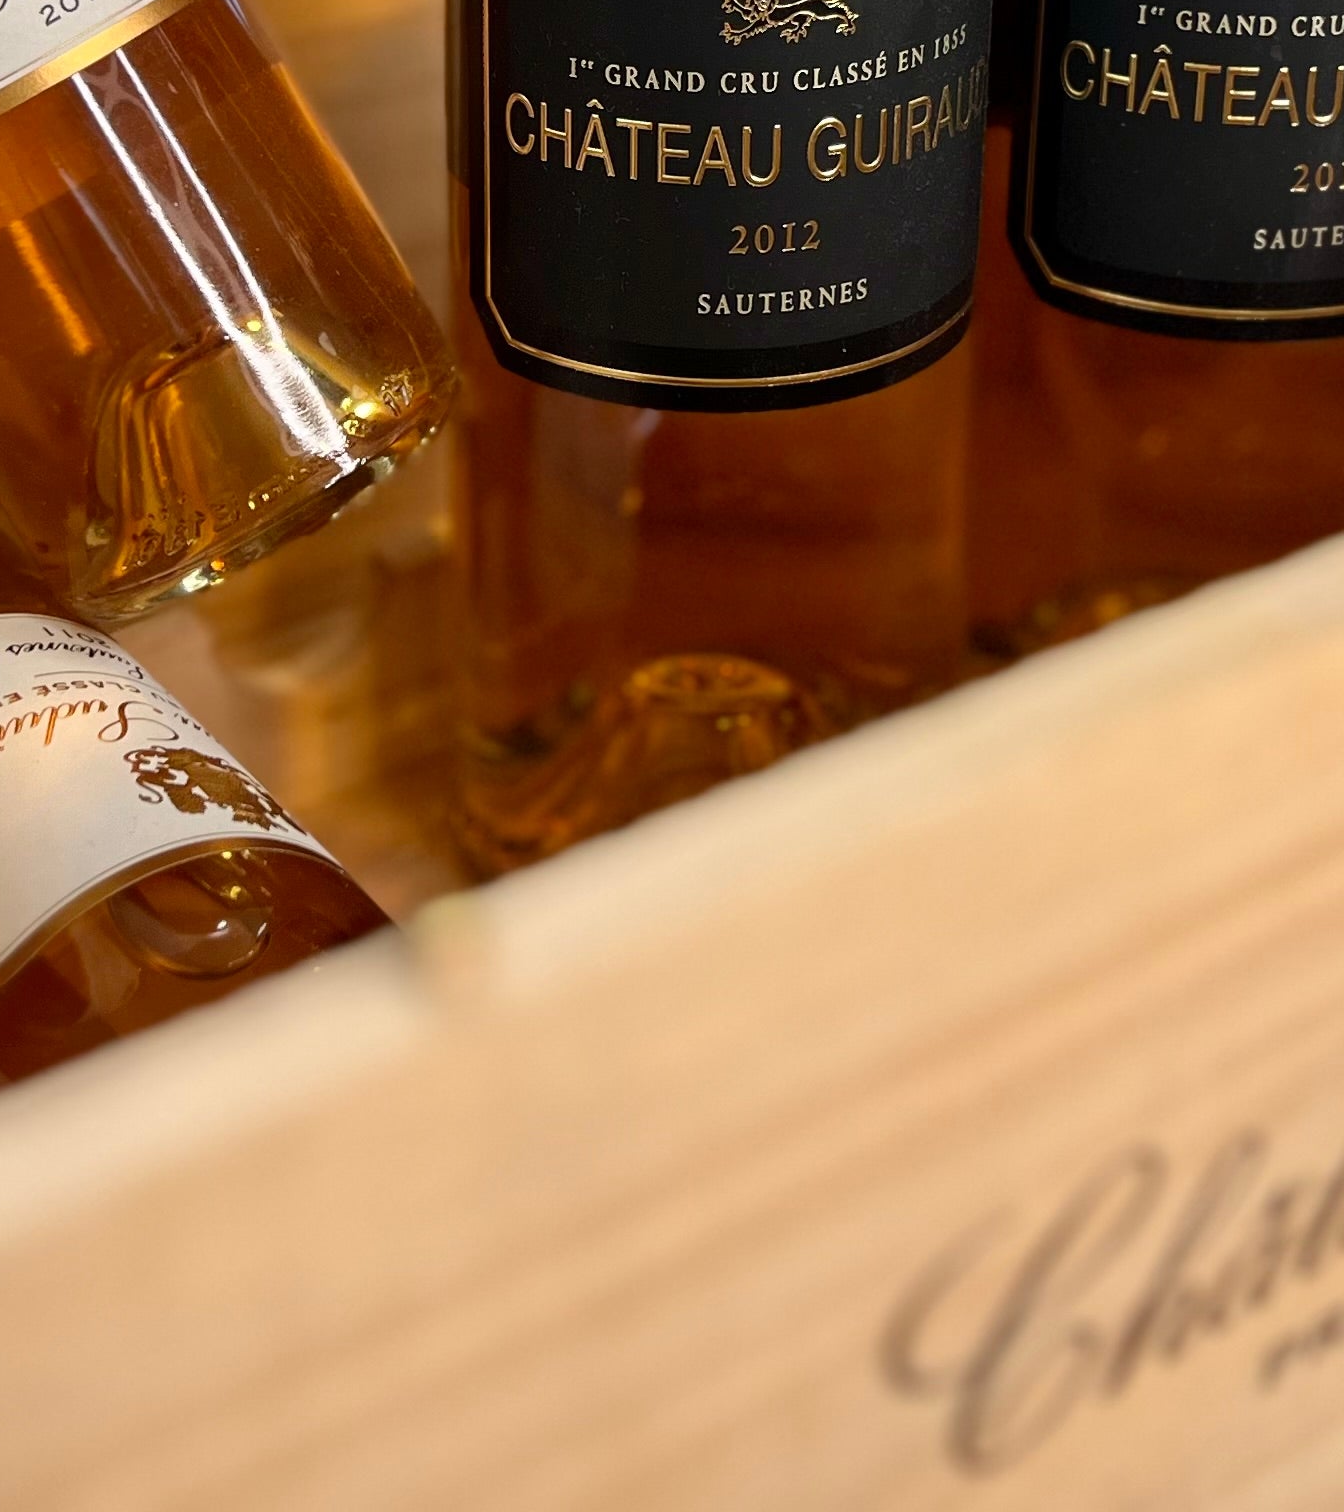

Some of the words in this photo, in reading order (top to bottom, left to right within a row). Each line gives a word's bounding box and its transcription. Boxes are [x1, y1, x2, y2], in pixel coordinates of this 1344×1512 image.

[1175, 8, 1278, 38] GRAND
[605, 65, 706, 93] GRAND
[720, 71, 780, 94] CRU
[793, 52, 888, 91] CLASSÉ
[898, 43, 925, 73] EN
[933, 23, 968, 60] 1855
[504, 92, 782, 188] CHÂTEAU
[727, 219, 822, 255] 2012
[697, 277, 869, 316] SAUTERNES
